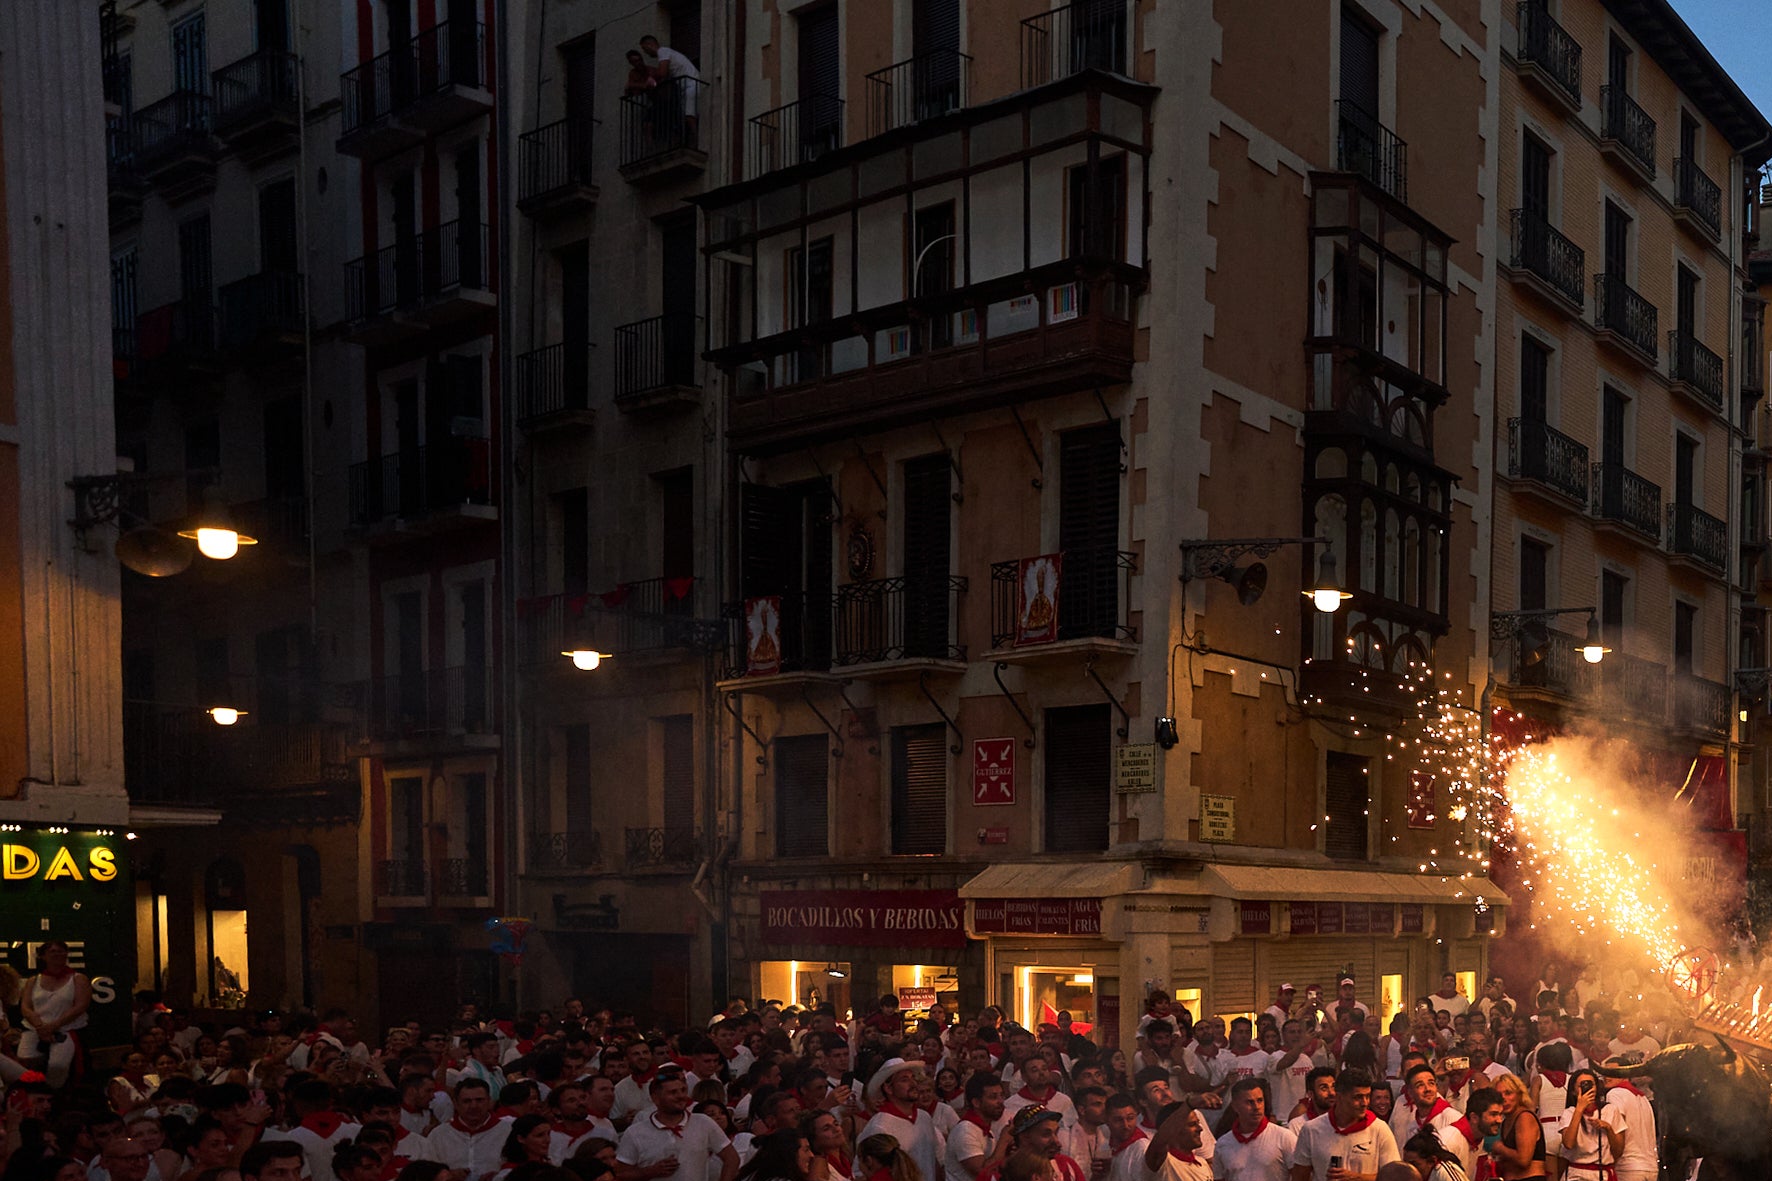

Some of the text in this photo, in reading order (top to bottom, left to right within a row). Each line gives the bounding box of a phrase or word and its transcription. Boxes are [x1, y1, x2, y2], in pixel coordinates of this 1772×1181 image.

[768, 906, 960, 930] BOCADILLOS Y BEBIDAS
[976, 909, 1005, 920] HIELOS
[1242, 910, 1270, 921] HIELOS
